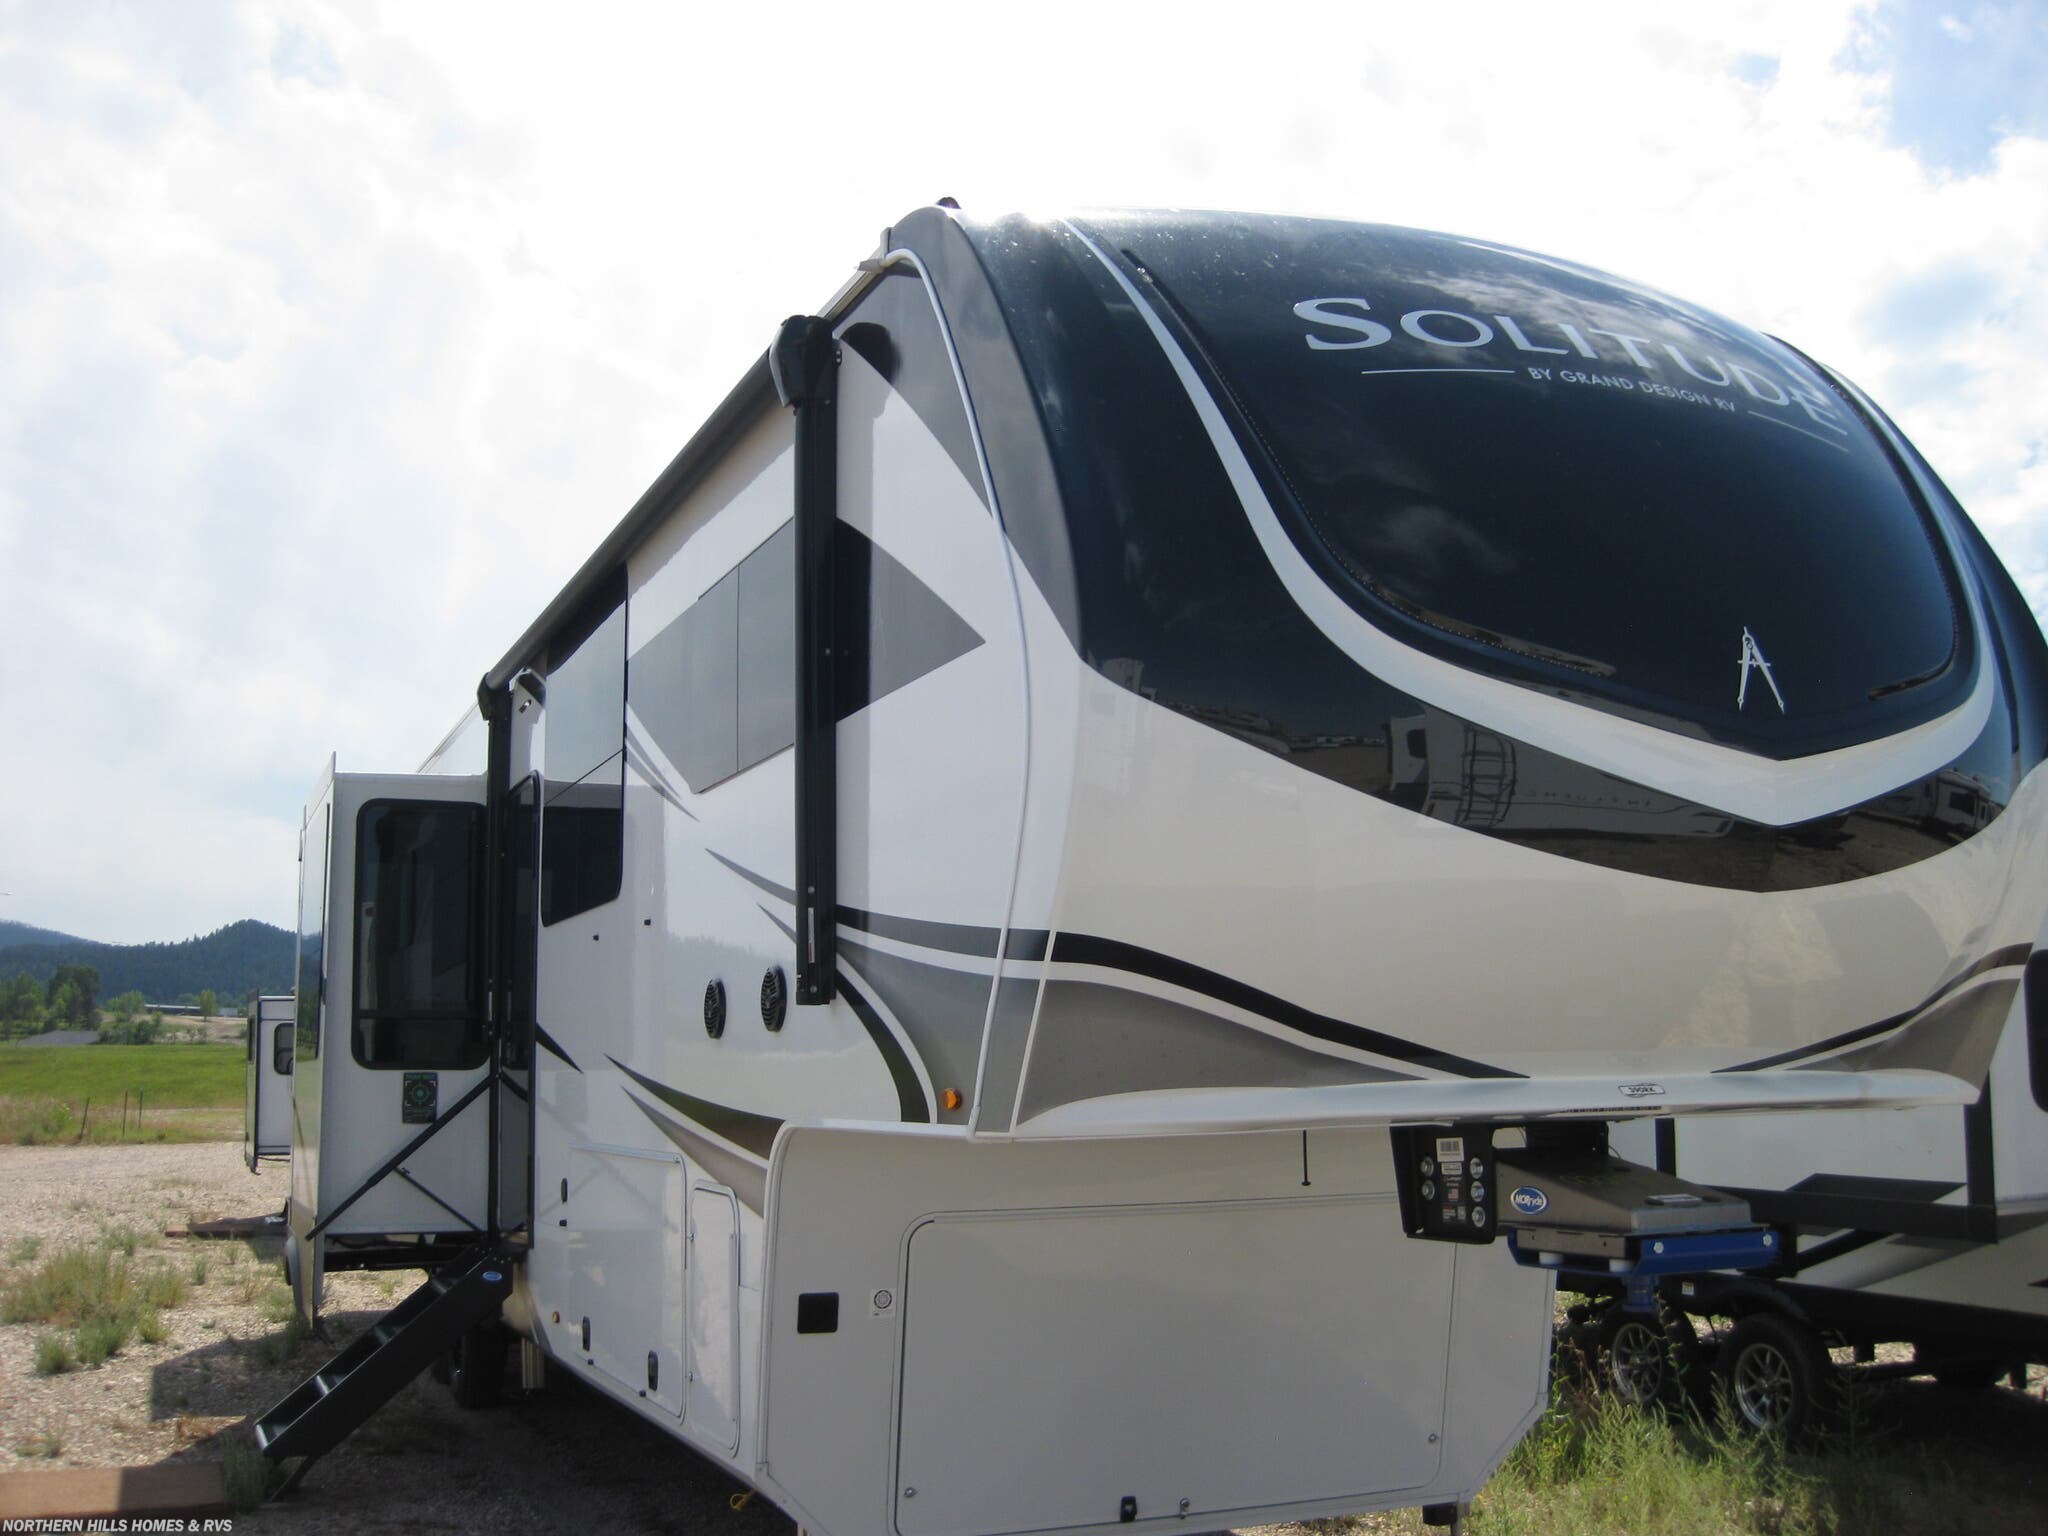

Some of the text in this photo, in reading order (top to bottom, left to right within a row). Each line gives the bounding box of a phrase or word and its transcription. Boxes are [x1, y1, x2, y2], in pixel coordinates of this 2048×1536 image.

[1293, 297, 1847, 436] SOLITUDE
[1527, 367, 1736, 412] BY GRAND DESIGN RV
